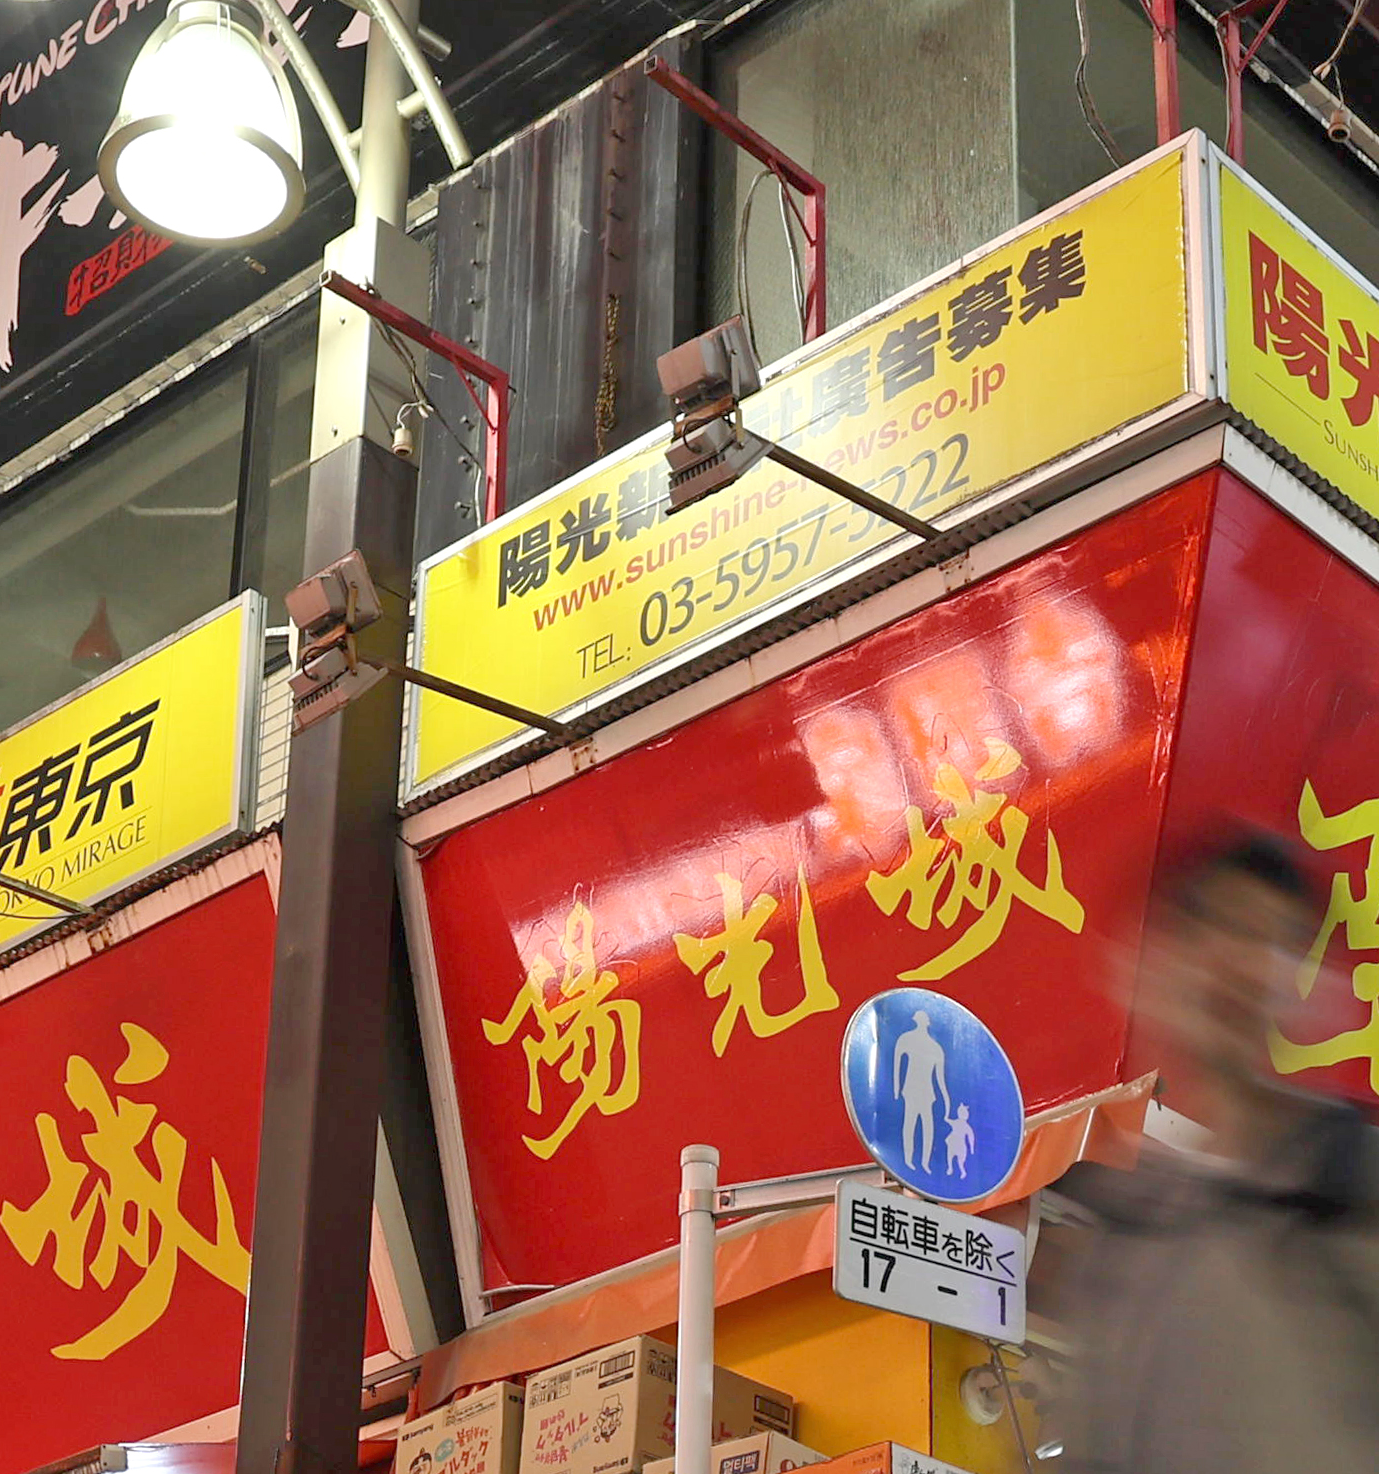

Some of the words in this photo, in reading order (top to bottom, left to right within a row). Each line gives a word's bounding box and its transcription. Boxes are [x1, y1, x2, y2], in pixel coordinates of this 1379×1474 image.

[60, 814, 148, 883] MIRAGE
[482, 736, 1087, 1161] 陽光城
[849, 1196, 1019, 1280] 自転車を除く
